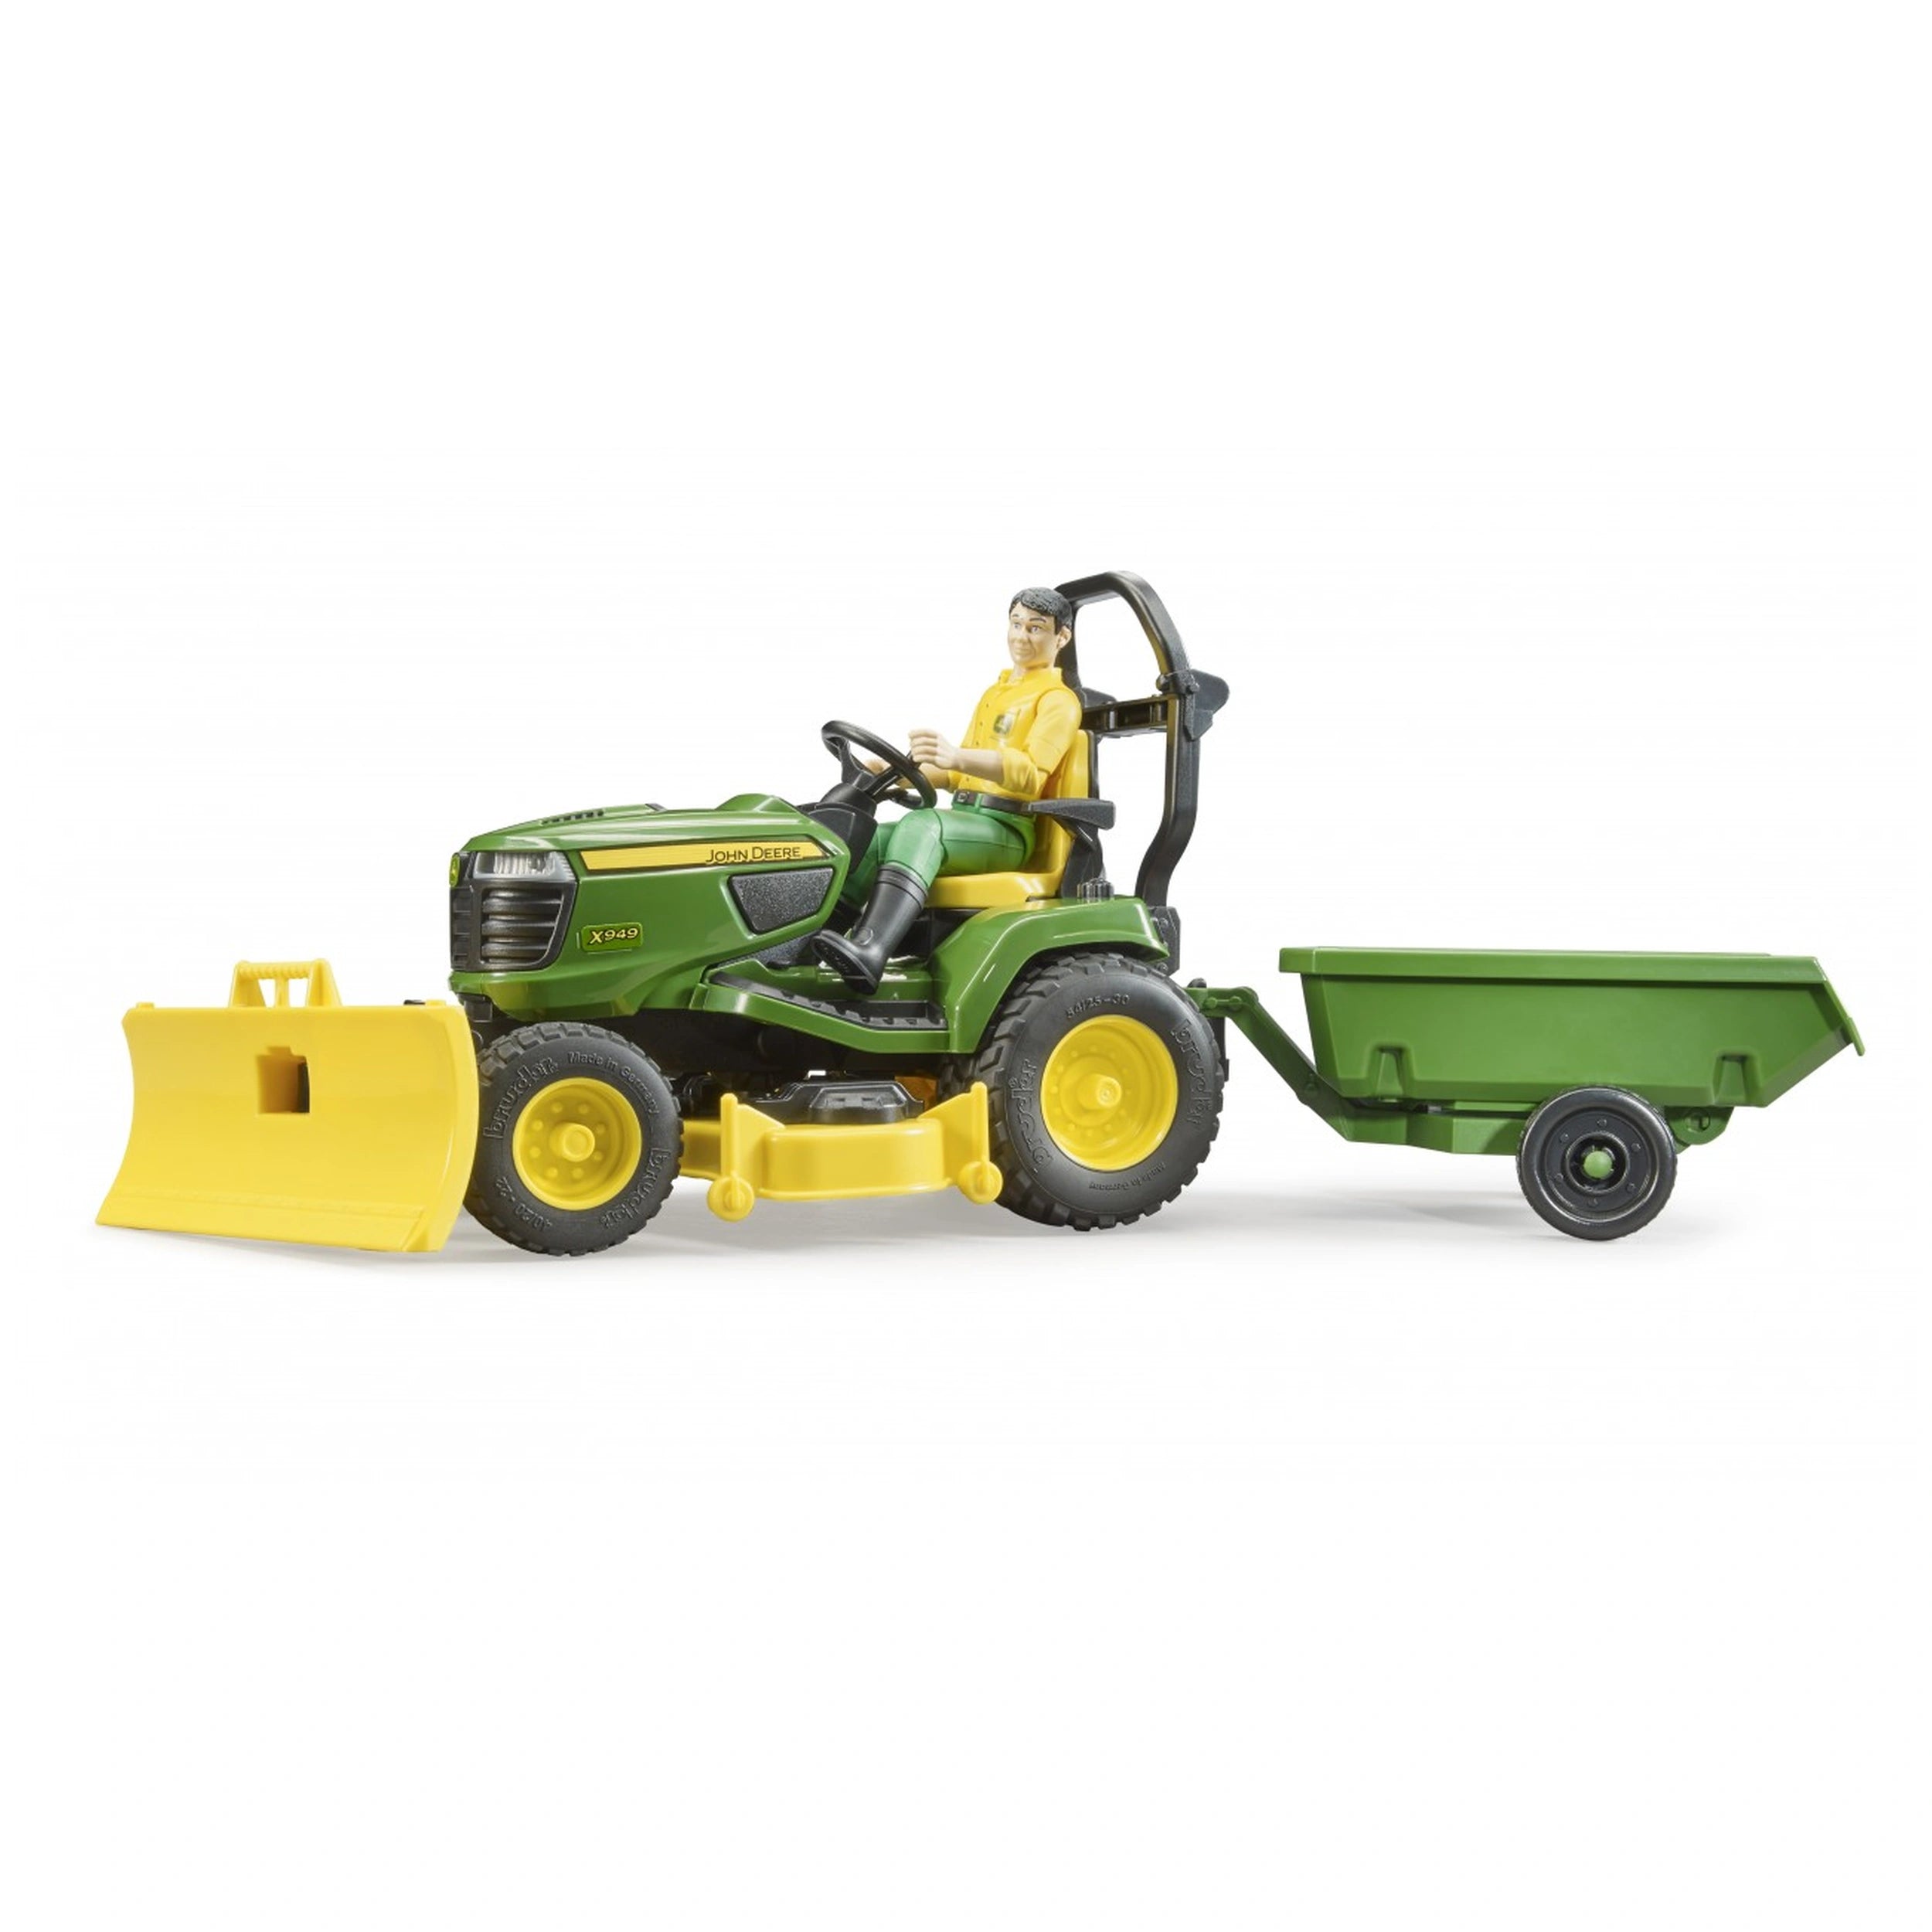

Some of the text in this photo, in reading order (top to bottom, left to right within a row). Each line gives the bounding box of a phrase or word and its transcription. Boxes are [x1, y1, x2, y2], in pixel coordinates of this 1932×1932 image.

[706, 846, 801, 862] JOHN DEERE
[590, 927, 638, 944] X949
[484, 1056, 558, 1138] bruder
[568, 1051, 660, 1114] Made in Germany
[1171, 1019, 1213, 1124] bruder
[600, 1148, 671, 1227] bruder
